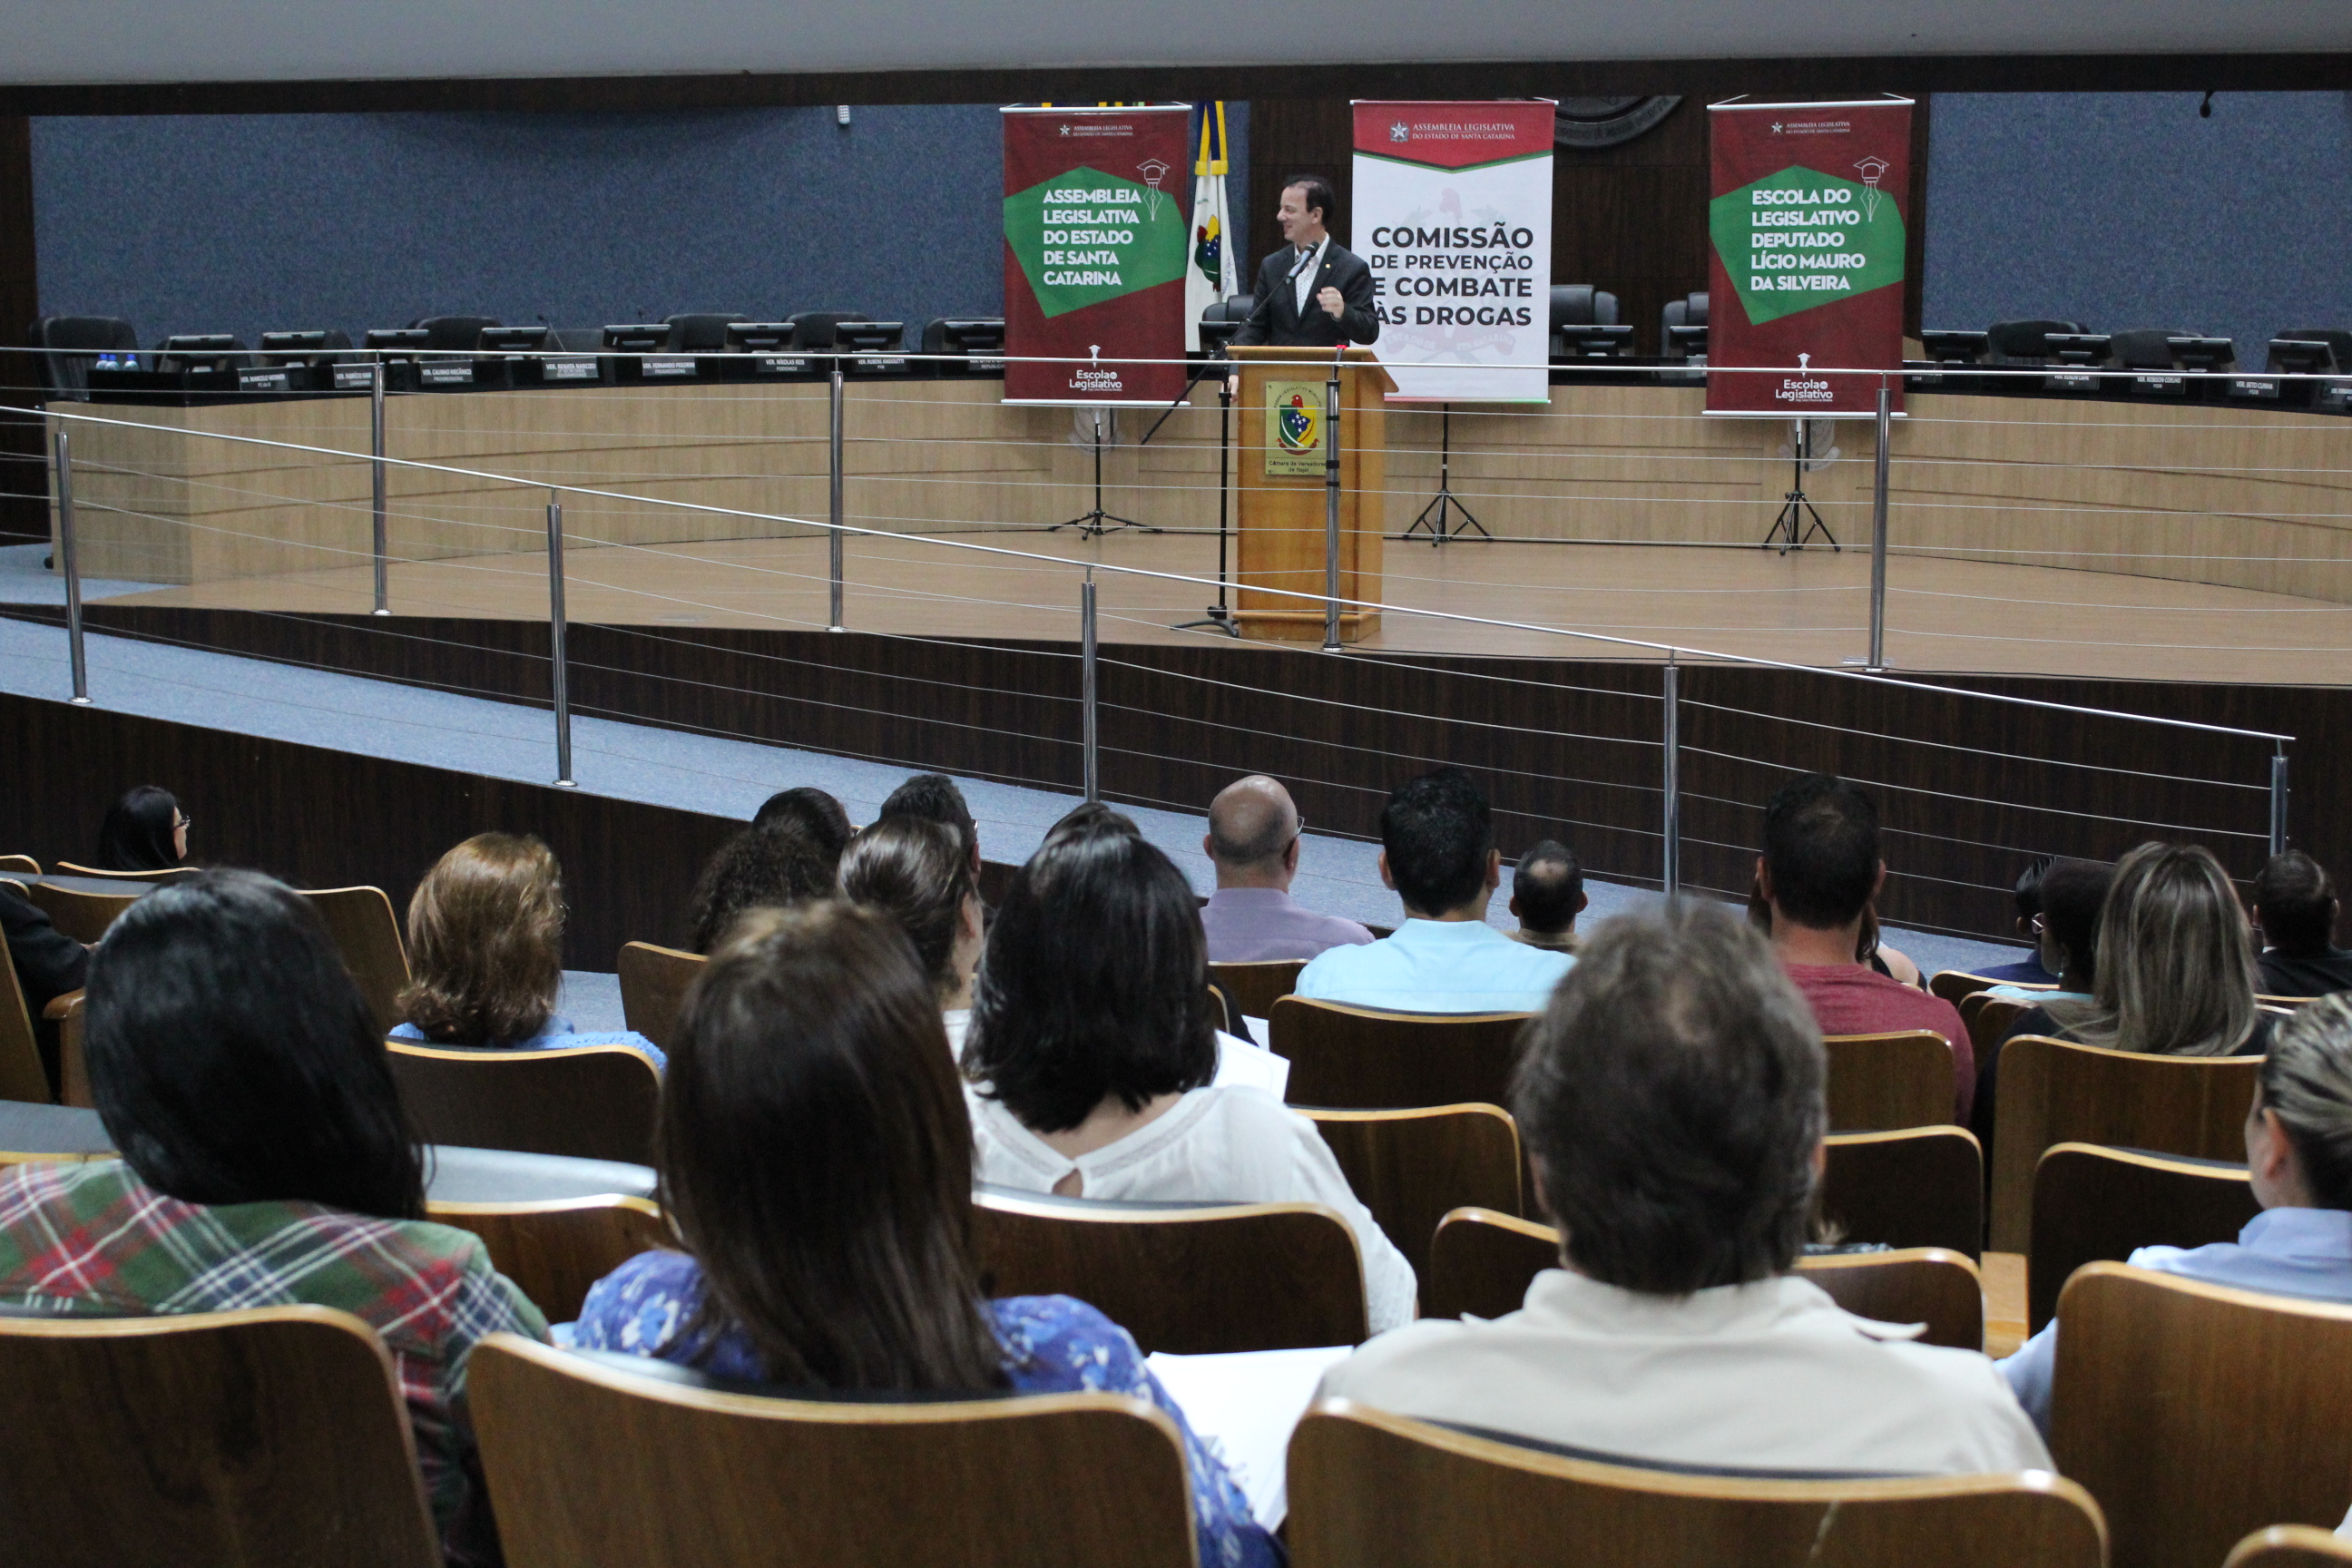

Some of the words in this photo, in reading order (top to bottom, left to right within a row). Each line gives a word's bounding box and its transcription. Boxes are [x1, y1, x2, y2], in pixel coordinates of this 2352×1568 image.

[1044, 189, 1142, 203] ASSEMBLEIA
[1753, 190, 1820, 204] ESCOLA
[1824, 189, 1851, 203] DO
[1044, 210, 1140, 223] LEGISLATIVA
[1752, 211, 1860, 226] LEGISLATIVO
[1044, 230, 1068, 244] DO
[1071, 230, 1132, 244] ESTADO
[1372, 222, 1533, 249] COMISSÃO
[1752, 232, 1845, 248] DEPUTADO
[1044, 250, 1064, 264] DE
[1067, 250, 1119, 264] SANTA
[1372, 255, 1397, 269] DE
[1406, 252, 1533, 273] PREVENÇÃO
[1752, 250, 1797, 269] LÍCIO
[1800, 253, 1866, 269] MAURO
[1044, 271, 1122, 285] CATARINA
[1751, 276, 1774, 290] DA
[1778, 275, 1850, 289] SILVEIRA
[1374, 277, 1386, 297] E
[1396, 278, 1532, 297] COMBATE
[1376, 301, 1406, 325] ÀS
[1416, 307, 1531, 326] DROGAS
[1077, 370, 1109, 378] Escola
[1070, 378, 1122, 390] Legislativo
[1784, 379, 1819, 388] Escola
[1776, 389, 1833, 401] Legislativo
